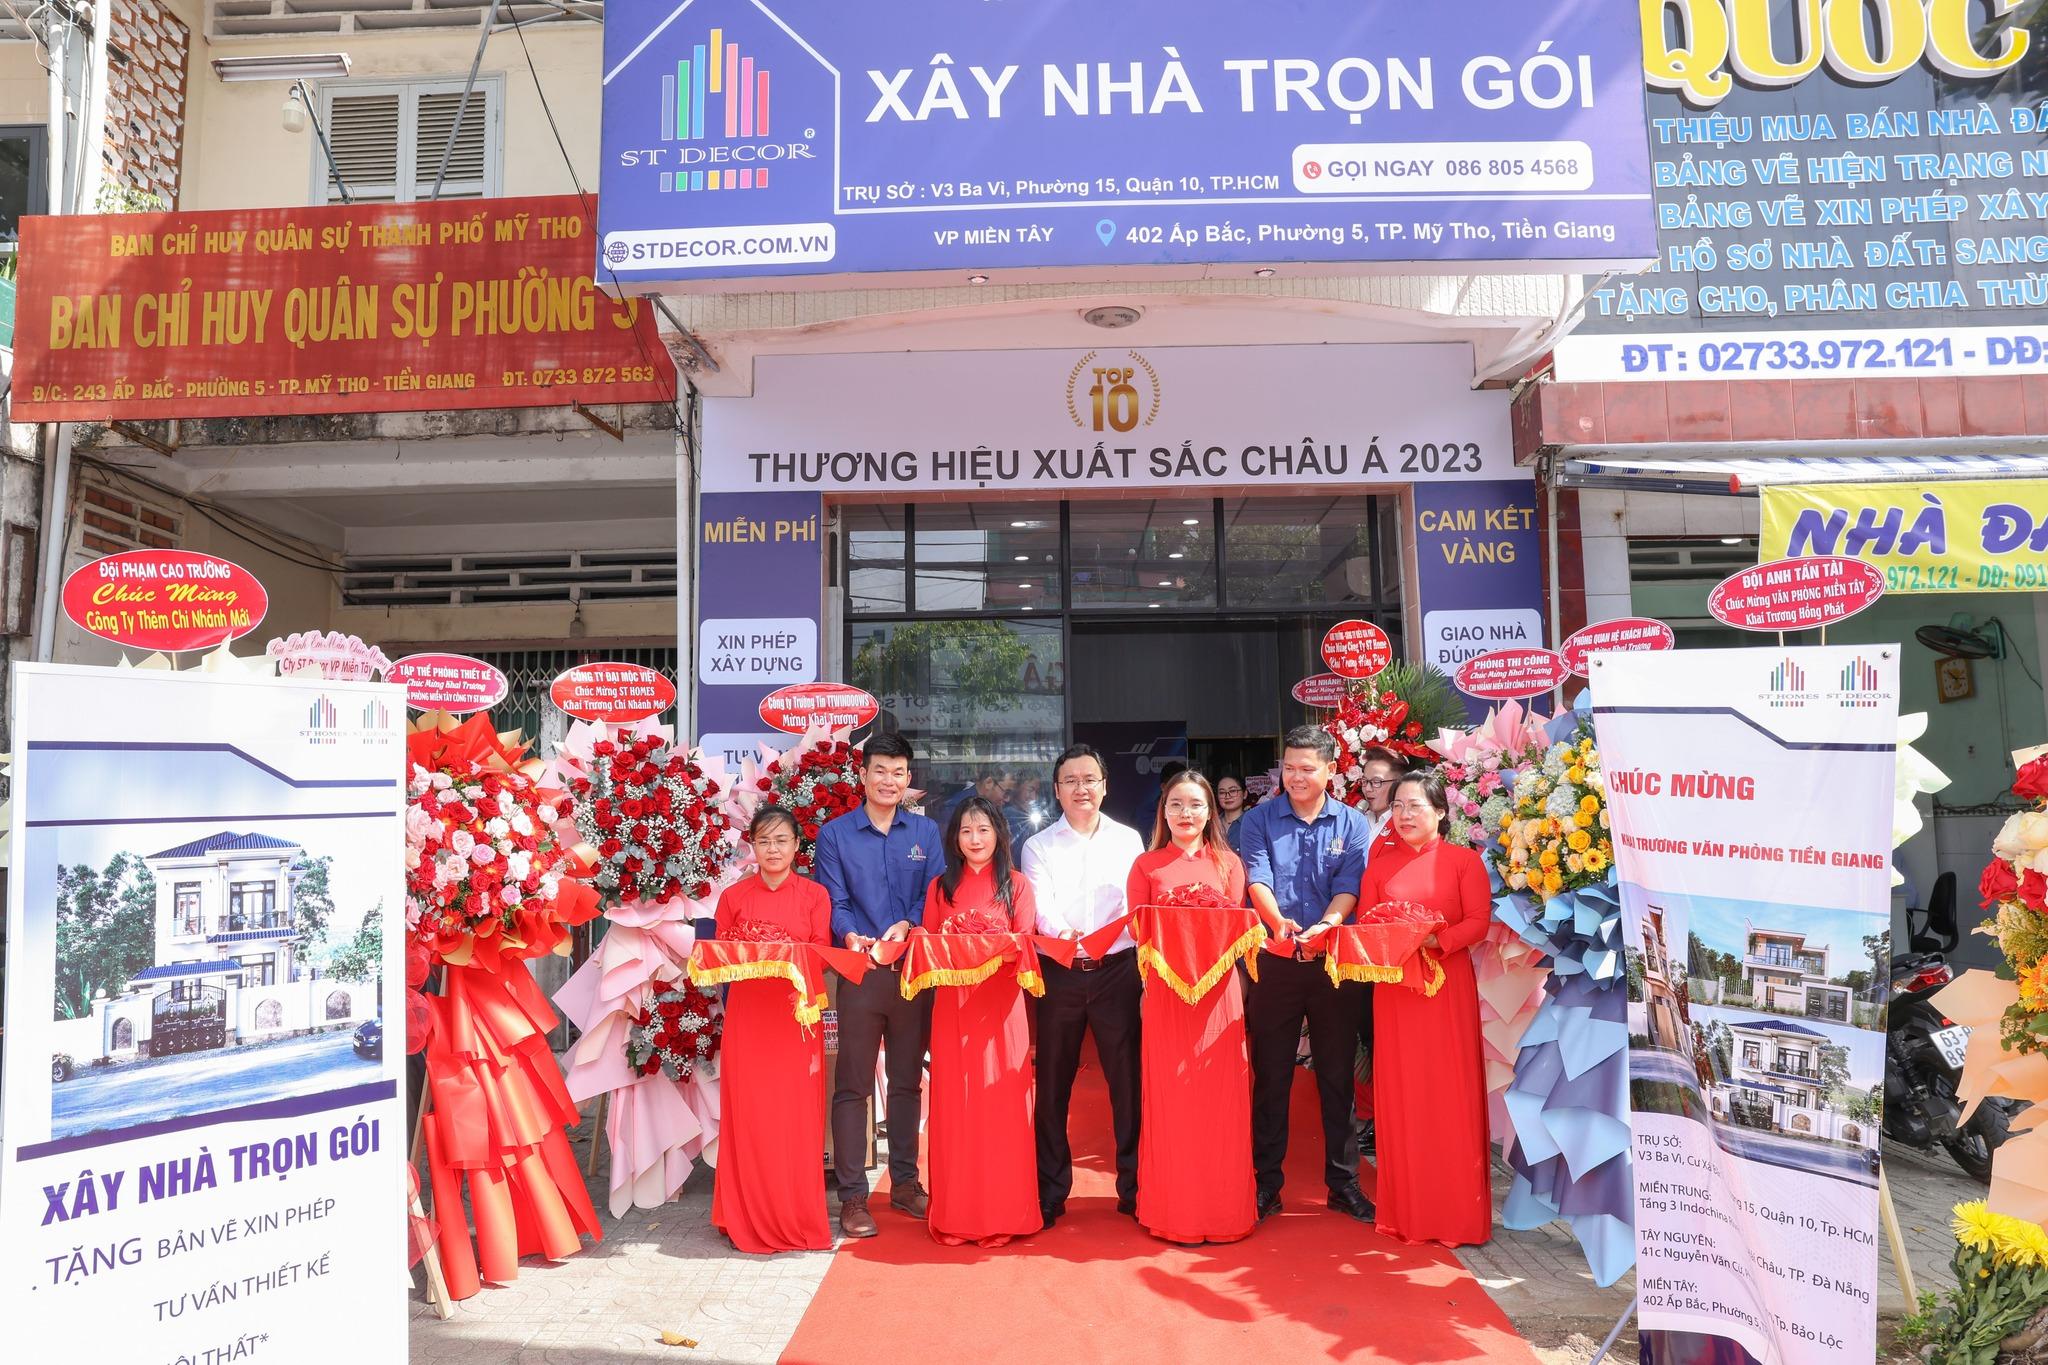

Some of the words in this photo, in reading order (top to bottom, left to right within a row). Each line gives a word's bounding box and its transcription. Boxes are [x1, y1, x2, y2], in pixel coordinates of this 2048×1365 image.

[865, 53, 1019, 123] XÂY
[1043, 46, 1204, 118] NHÀ
[1223, 57, 1435, 125] TRỌN
[1460, 40, 1594, 109] GÓI
[621, 149, 667, 167] ST
[680, 142, 817, 164] DECOR
[1327, 160, 1368, 183] GỌI
[1374, 159, 1435, 178] NGAY
[1446, 158, 1482, 177] 086
[1488, 158, 1526, 176] 805
[1530, 157, 1579, 176] 4568
[1654, 151, 1748, 189] BẢNG
[1752, 152, 1801, 185] VẼ
[1807, 152, 1887, 189] HIỆN
[1893, 150, 2014, 186] TRẠNG
[934, 231, 959, 246] VP
[964, 225, 1010, 245] MIỀN
[1015, 226, 1054, 244] TÂY
[1126, 226, 1163, 244] 402
[1169, 224, 1198, 247] Ấp
[1205, 221, 1251, 245] Bắc,
[1257, 223, 1345, 245] Phường
[1351, 223, 1370, 244] 5,
[1375, 223, 1408, 241] TP.
[1413, 219, 1444, 244] Mỹ
[1449, 220, 1496, 243] Tho,
[1501, 217, 1547, 240] Tiền
[1553, 220, 1616, 243] Giang
[632, 235, 829, 261] STDECOR.COM.VN
[50, 293, 121, 351] BAN
[134, 278, 193, 349] CHỈ
[202, 288, 273, 346] HUY
[284, 275, 378, 349] QUÂN
[391, 271, 443, 349] SỰ
[452, 264, 594, 336] PHƯỜNG
[1592, 282, 1689, 322] TẶNG
[1697, 284, 1778, 319] CHO,
[1783, 276, 1878, 313] PHÂN
[1883, 280, 1968, 310] CHIA
[1621, 343, 1687, 373] ĐT:
[1698, 337, 1953, 372] 02733.972.121
[32, 382, 67, 404] Đ/C:
[73, 384, 106, 400] 243
[112, 375, 135, 400] ẤP
[142, 375, 174, 399] BẮC
[186, 375, 249, 397] PHƯỜNG
[255, 380, 265, 396] 5
[337, 376, 370, 392] THO
[383, 366, 420, 391] TIỀN
[425, 373, 476, 390] GIANG
[502, 371, 527, 387] ĐT:
[533, 368, 577, 386] 0733
[583, 367, 616, 383] 872
[621, 366, 654, 382] 563
[1091, 367, 1135, 385] TOP
[1089, 383, 1139, 433] 10
[748, 449, 918, 483] THƯƠNG
[931, 445, 1020, 488] HIỆU
[1032, 441, 1138, 480] XUẤT
[1149, 439, 1228, 477] SẮC
[1241, 437, 1348, 476] CHÂU
[1361, 436, 1389, 474] Á
[1399, 443, 1483, 474] 2023
[704, 516, 766, 543] MIỄN
[774, 514, 817, 542] PHÍ
[1419, 509, 1477, 532] CAM
[1484, 503, 1534, 530] KẾT
[1786, 491, 1947, 557] NHÀ
[1441, 537, 1516, 564] VÀNG
[99, 561, 120, 581] Đội
[122, 562, 158, 582] PHẠM
[159, 564, 184, 578] CAO
[186, 560, 231, 579] TRƯỜNG
[1742, 571, 1763, 591] ĐỘI
[1766, 569, 1792, 586] ANH
[1793, 561, 1820, 581] TẤN
[1822, 559, 1844, 577] TÀI
[92, 582, 157, 606] Chúc
[165, 583, 238, 607] Mừng
[1725, 595, 1745, 611] Chúc
[1746, 594, 1771, 609] Mừng
[1771, 589, 1790, 605] VĂN
[1791, 586, 1821, 602] PHÒNG
[1823, 578, 1847, 598] MIỀN
[1847, 578, 1865, 594] TÂY
[86, 611, 119, 636] Công
[122, 611, 135, 635] Ty
[137, 609, 169, 630] Thêm
[171, 611, 189, 630] Chi
[191, 608, 228, 628] Nhánh
[1745, 613, 1765, 626] Khai
[1766, 609, 1797, 623] Trương
[1799, 602, 1822, 619] Hồng
[1823, 601, 1845, 616] Phát
[717, 634, 746, 650] XIN
[751, 630, 797, 649] PHÉP
[1440, 626, 1485, 641] GIAO
[1490, 621, 1527, 640] NHÀ
[711, 654, 746, 673] XÂY
[751, 656, 803, 676] DỰNG
[1474, 658, 1505, 670] PHÒNG
[1507, 657, 1521, 668] THI
[1523, 654, 1550, 666] CÔNG
[595, 671, 604, 682] TY
[574, 686, 593, 697] Chúc
[595, 685, 618, 699] Mừng
[619, 686, 629, 697] ST
[630, 686, 655, 696] HOMES
[1609, 767, 1662, 796] CHÚC
[1670, 770, 1755, 801] MỪNG
[1636, 836, 1688, 854] TRƯƠNG
[1692, 840, 1724, 858] VĂN
[1728, 842, 1784, 863] PHÒNG
[1788, 844, 1826, 865] TIỀN
[1831, 851, 1884, 870] GIANG
[1939, 1026, 1975, 1048] 63-P
[1637, 1134, 1660, 1148] TRỤ
[1663, 1134, 1682, 1149] SỞ:
[40, 1168, 126, 1227] XÂY
[139, 1145, 218, 1204] NHÀ
[229, 1131, 318, 1183] TRỌN
[329, 1114, 380, 1161] GÓI
[1641, 1228, 1661, 1241] TÂY
[1663, 1231, 1716, 1249] NGUYÊN:
[1760, 1206, 1794, 1227] Quận
[1799, 1216, 1818, 1232] 10,
[1820, 1220, 1840, 1237] Tp.
[1843, 1226, 1874, 1246] HCM
[44, 1236, 144, 1287] TẶNG
[156, 1228, 206, 1260] BẢN
[210, 1218, 238, 1245] VẼ
[242, 1211, 279, 1237] XIN
[284, 1197, 336, 1227] PHÉP
[153, 1293, 188, 1322] TƯ
[191, 1281, 238, 1311] VẤN
[241, 1263, 302, 1297] THIẾT
[306, 1250, 332, 1278] KẾ
